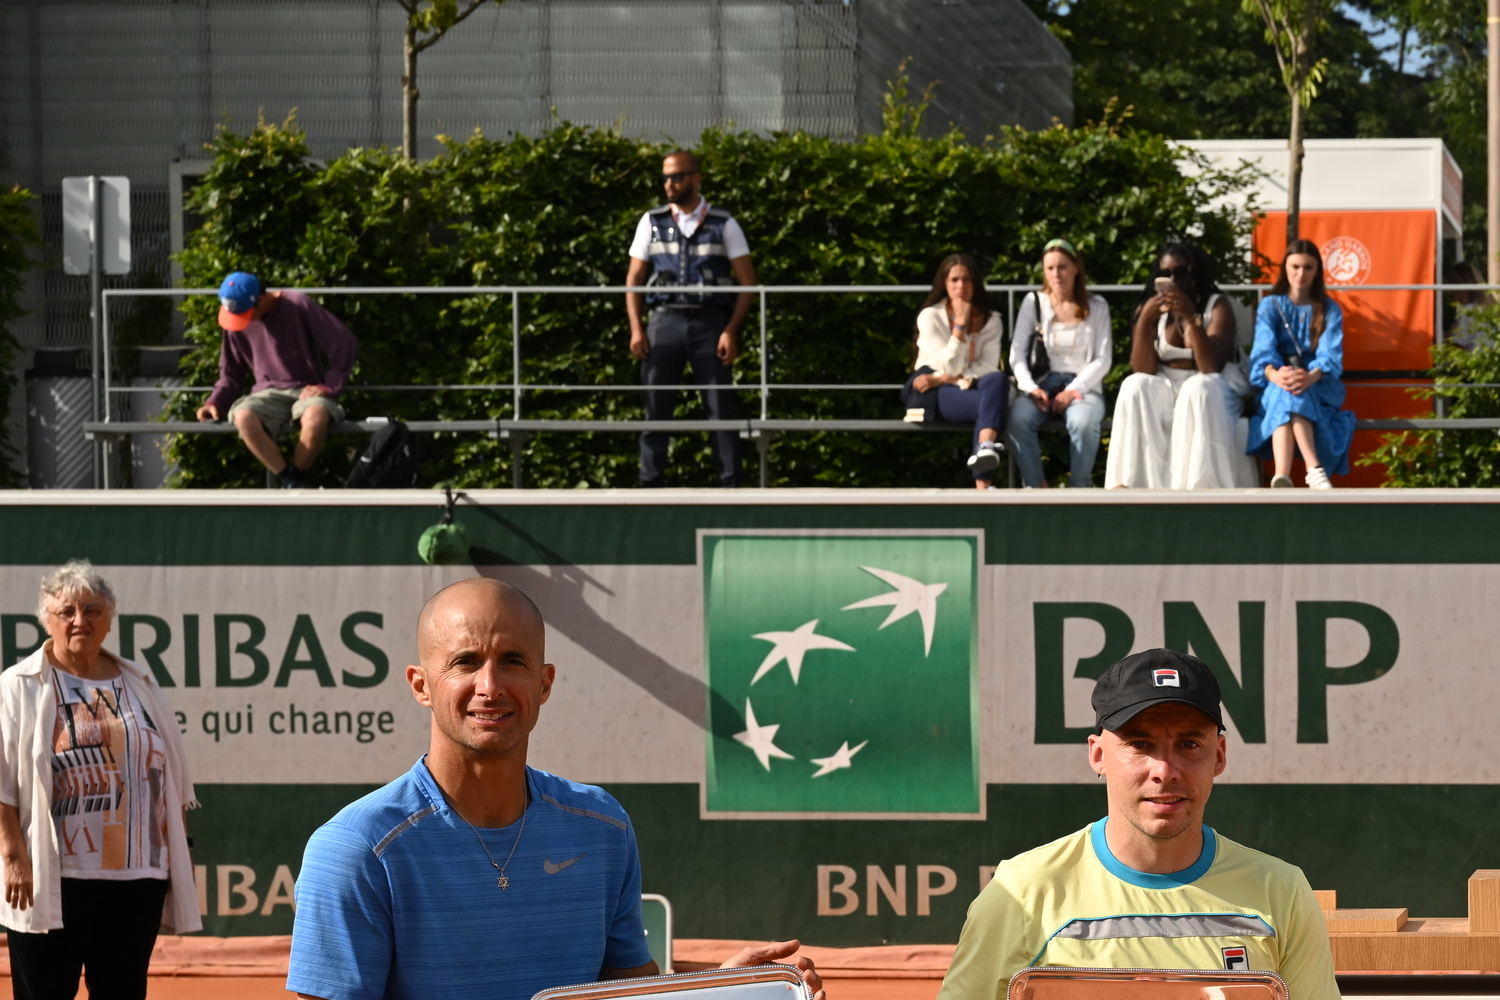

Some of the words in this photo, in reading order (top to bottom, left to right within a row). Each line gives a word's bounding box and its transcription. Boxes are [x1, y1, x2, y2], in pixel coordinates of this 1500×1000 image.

[1, 610, 390, 689] PRIBAS
[1033, 601, 1400, 745] BNP
[201, 704, 253, 743] qui
[268, 703, 395, 744] change
[816, 864, 958, 917] BNP
